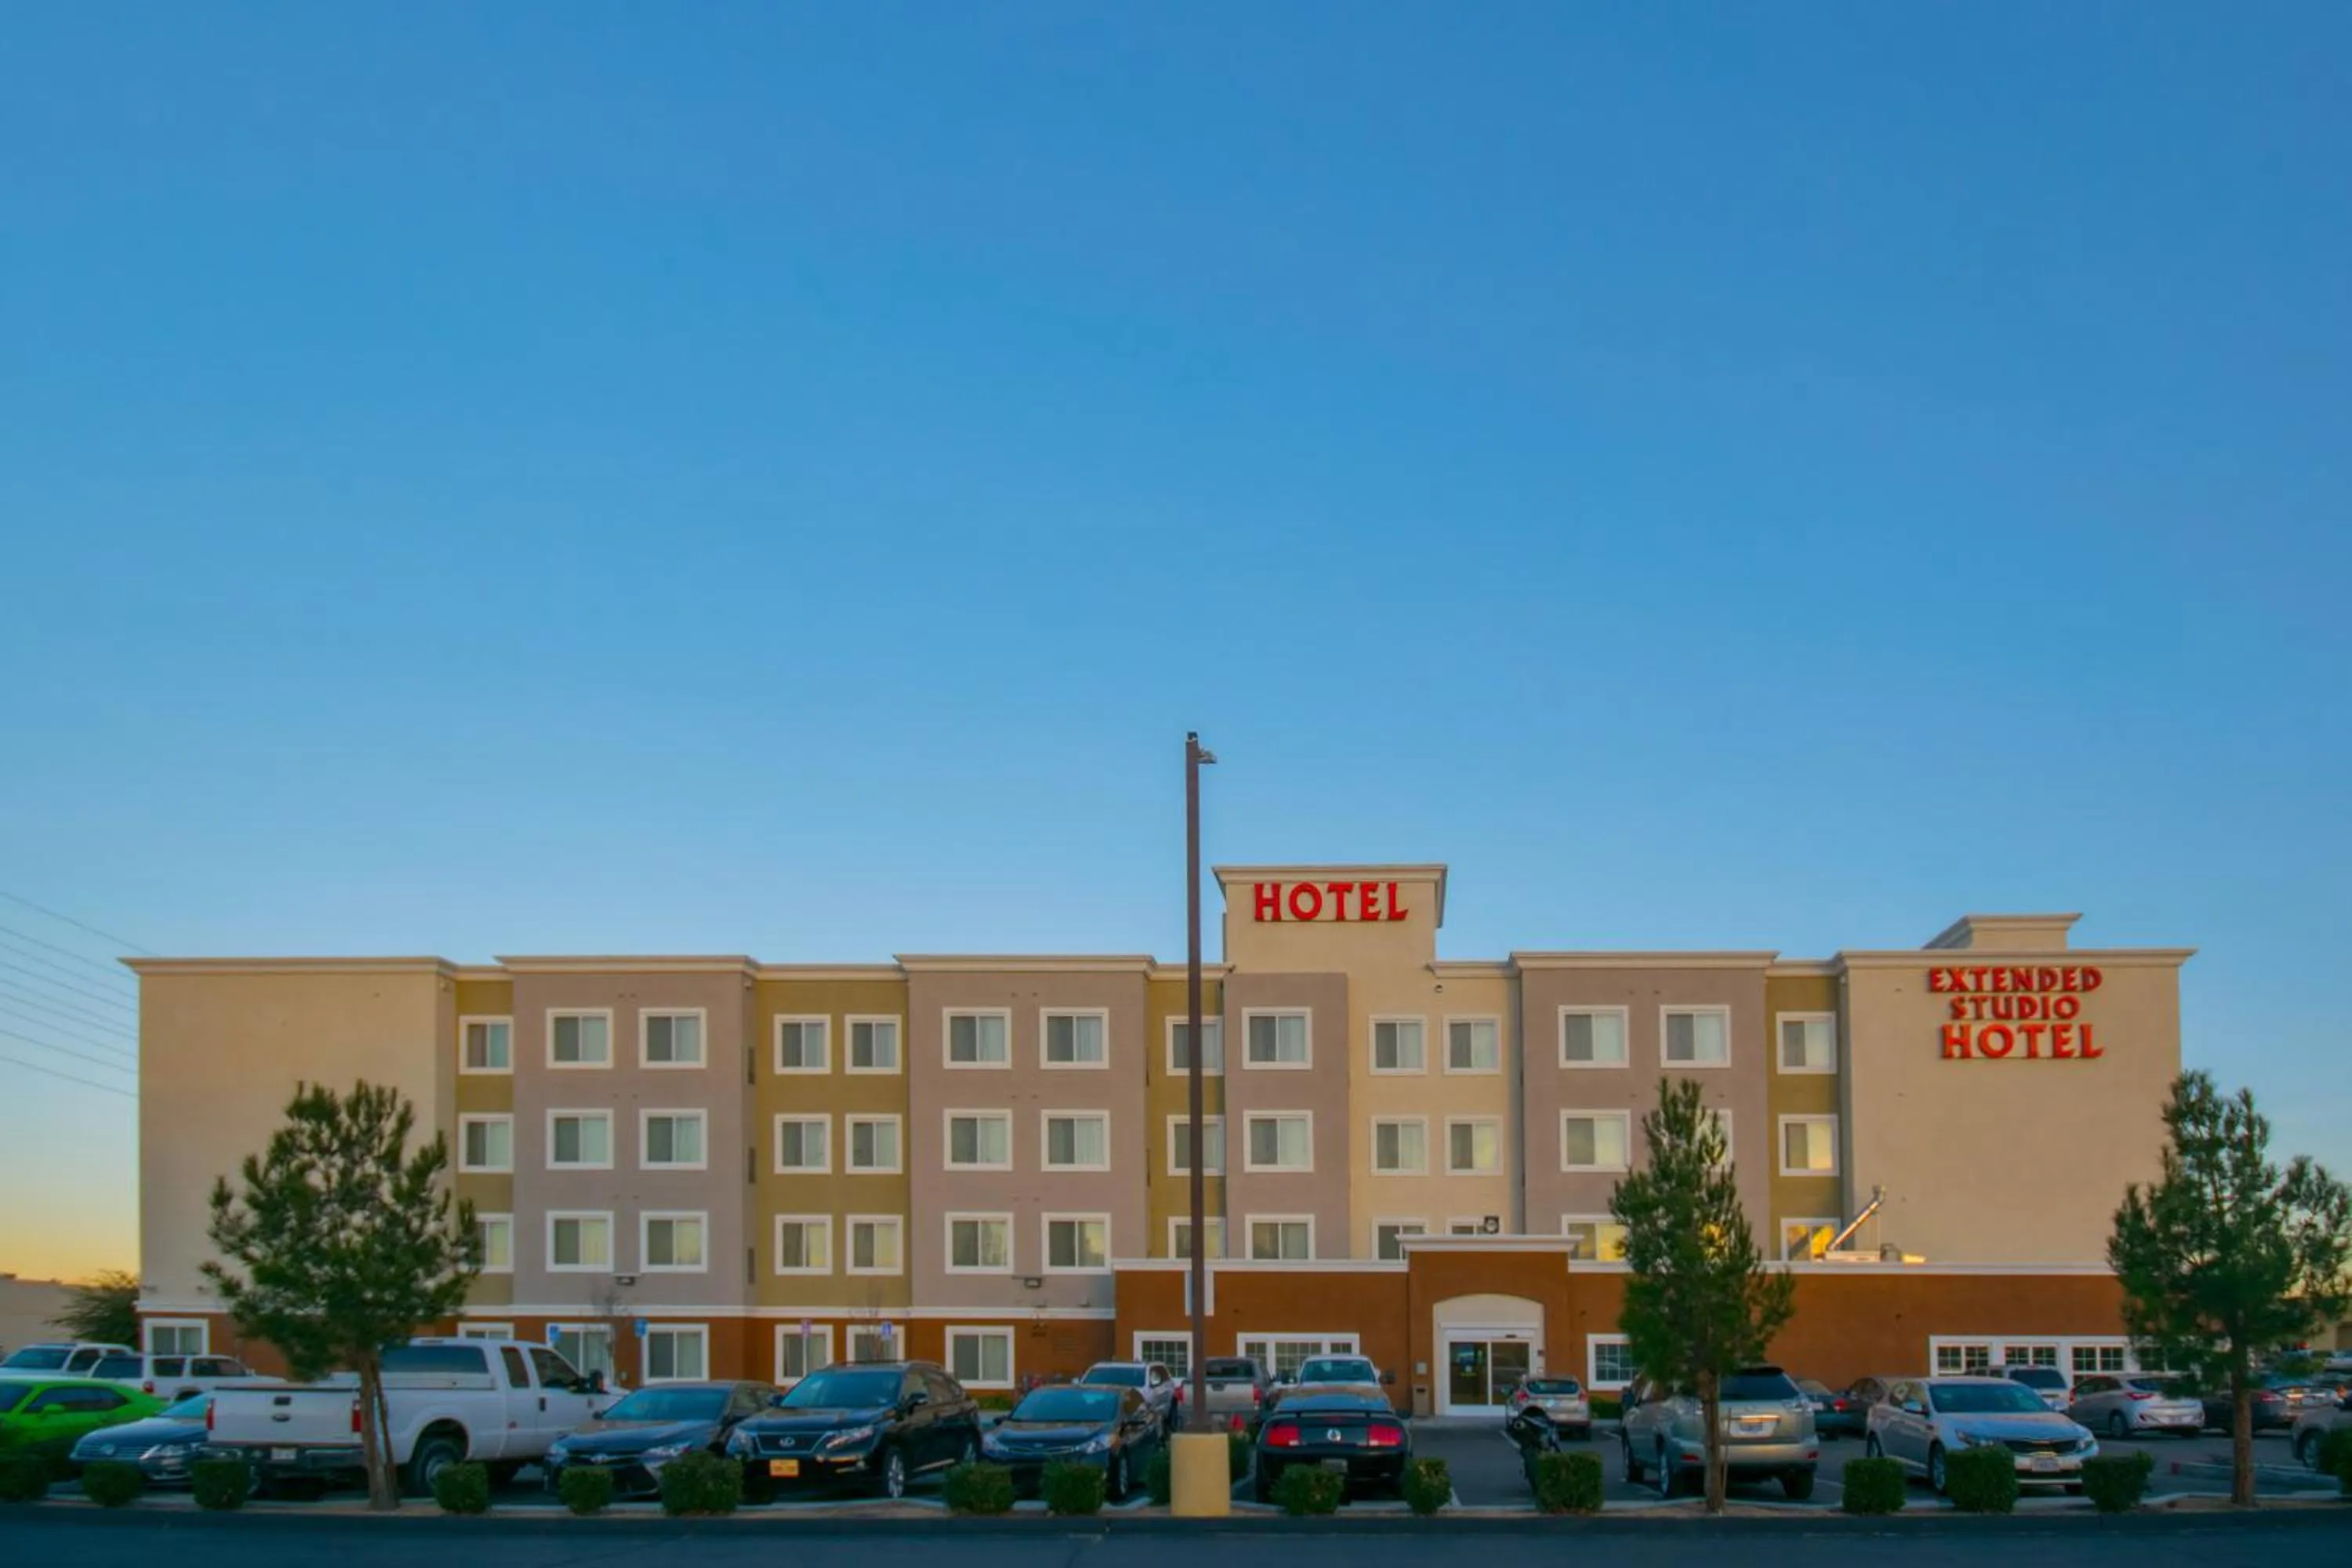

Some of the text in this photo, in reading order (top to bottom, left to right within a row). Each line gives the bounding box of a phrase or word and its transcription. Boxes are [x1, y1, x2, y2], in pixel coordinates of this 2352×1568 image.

[1254, 881, 1408, 921] HOTEL
[1929, 967, 2103, 993] EXTENDED
[1950, 995, 2081, 1019] STUDIO
[1940, 1023, 2105, 1058] HOTEL
